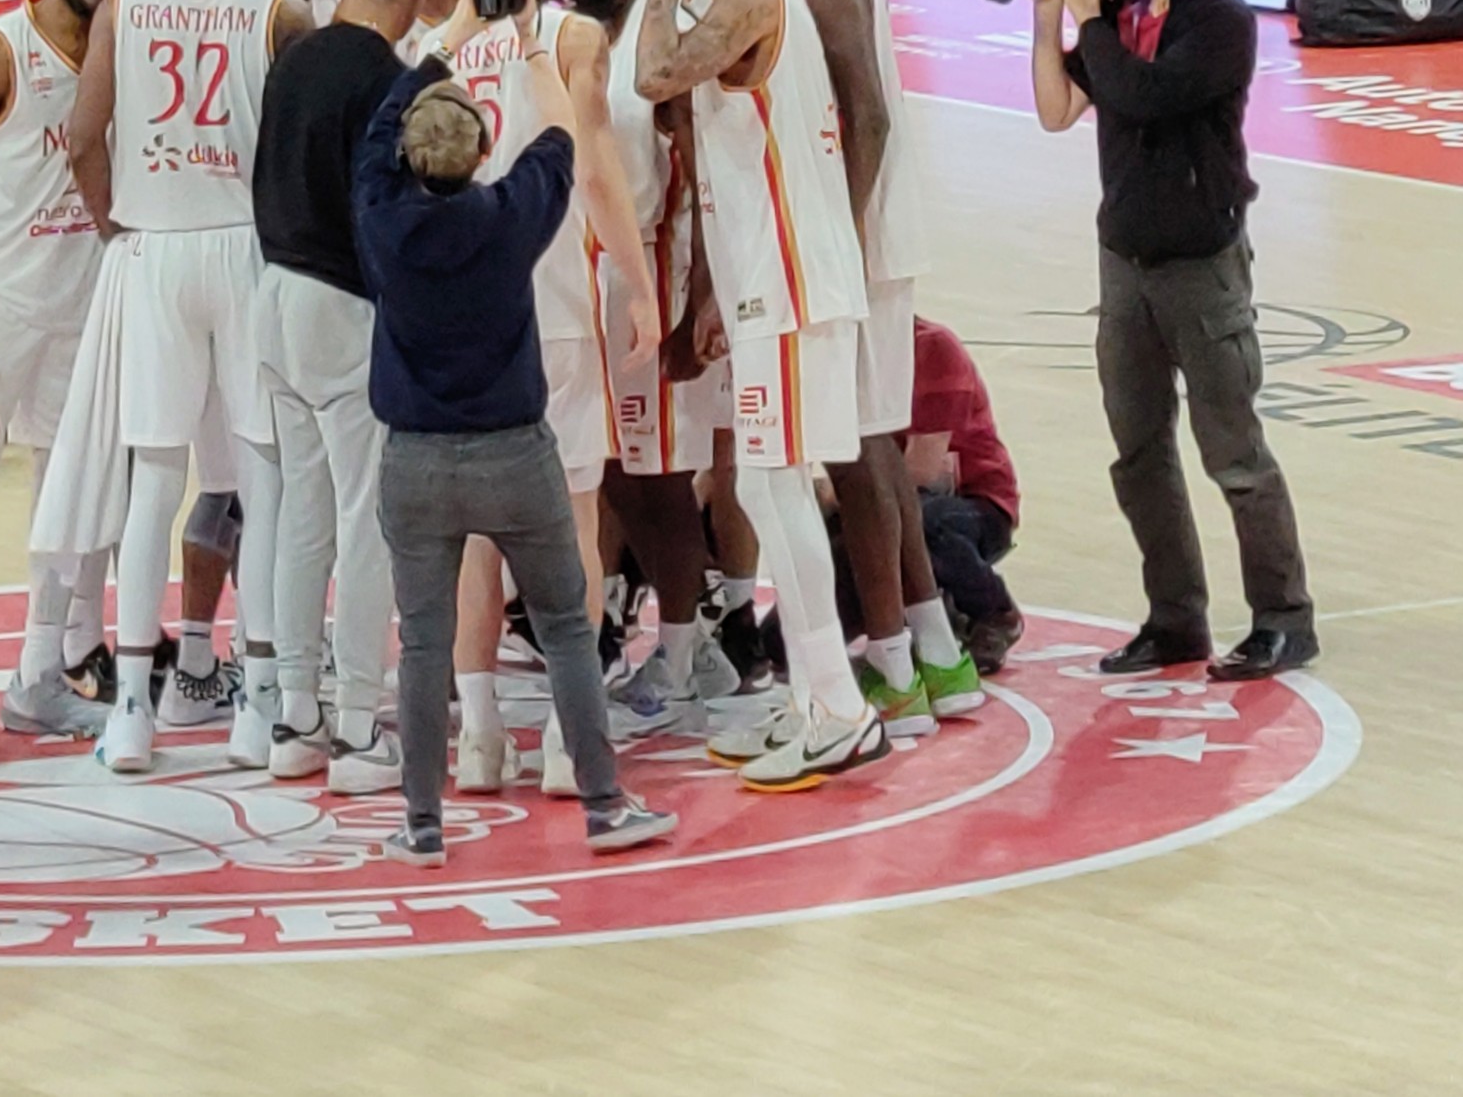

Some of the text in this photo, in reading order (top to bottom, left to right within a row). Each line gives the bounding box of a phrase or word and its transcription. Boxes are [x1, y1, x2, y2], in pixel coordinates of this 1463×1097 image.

[130, 4, 257, 34] GRANTHAM
[456, 36, 525, 71] RISCH
[148, 38, 231, 125] 32
